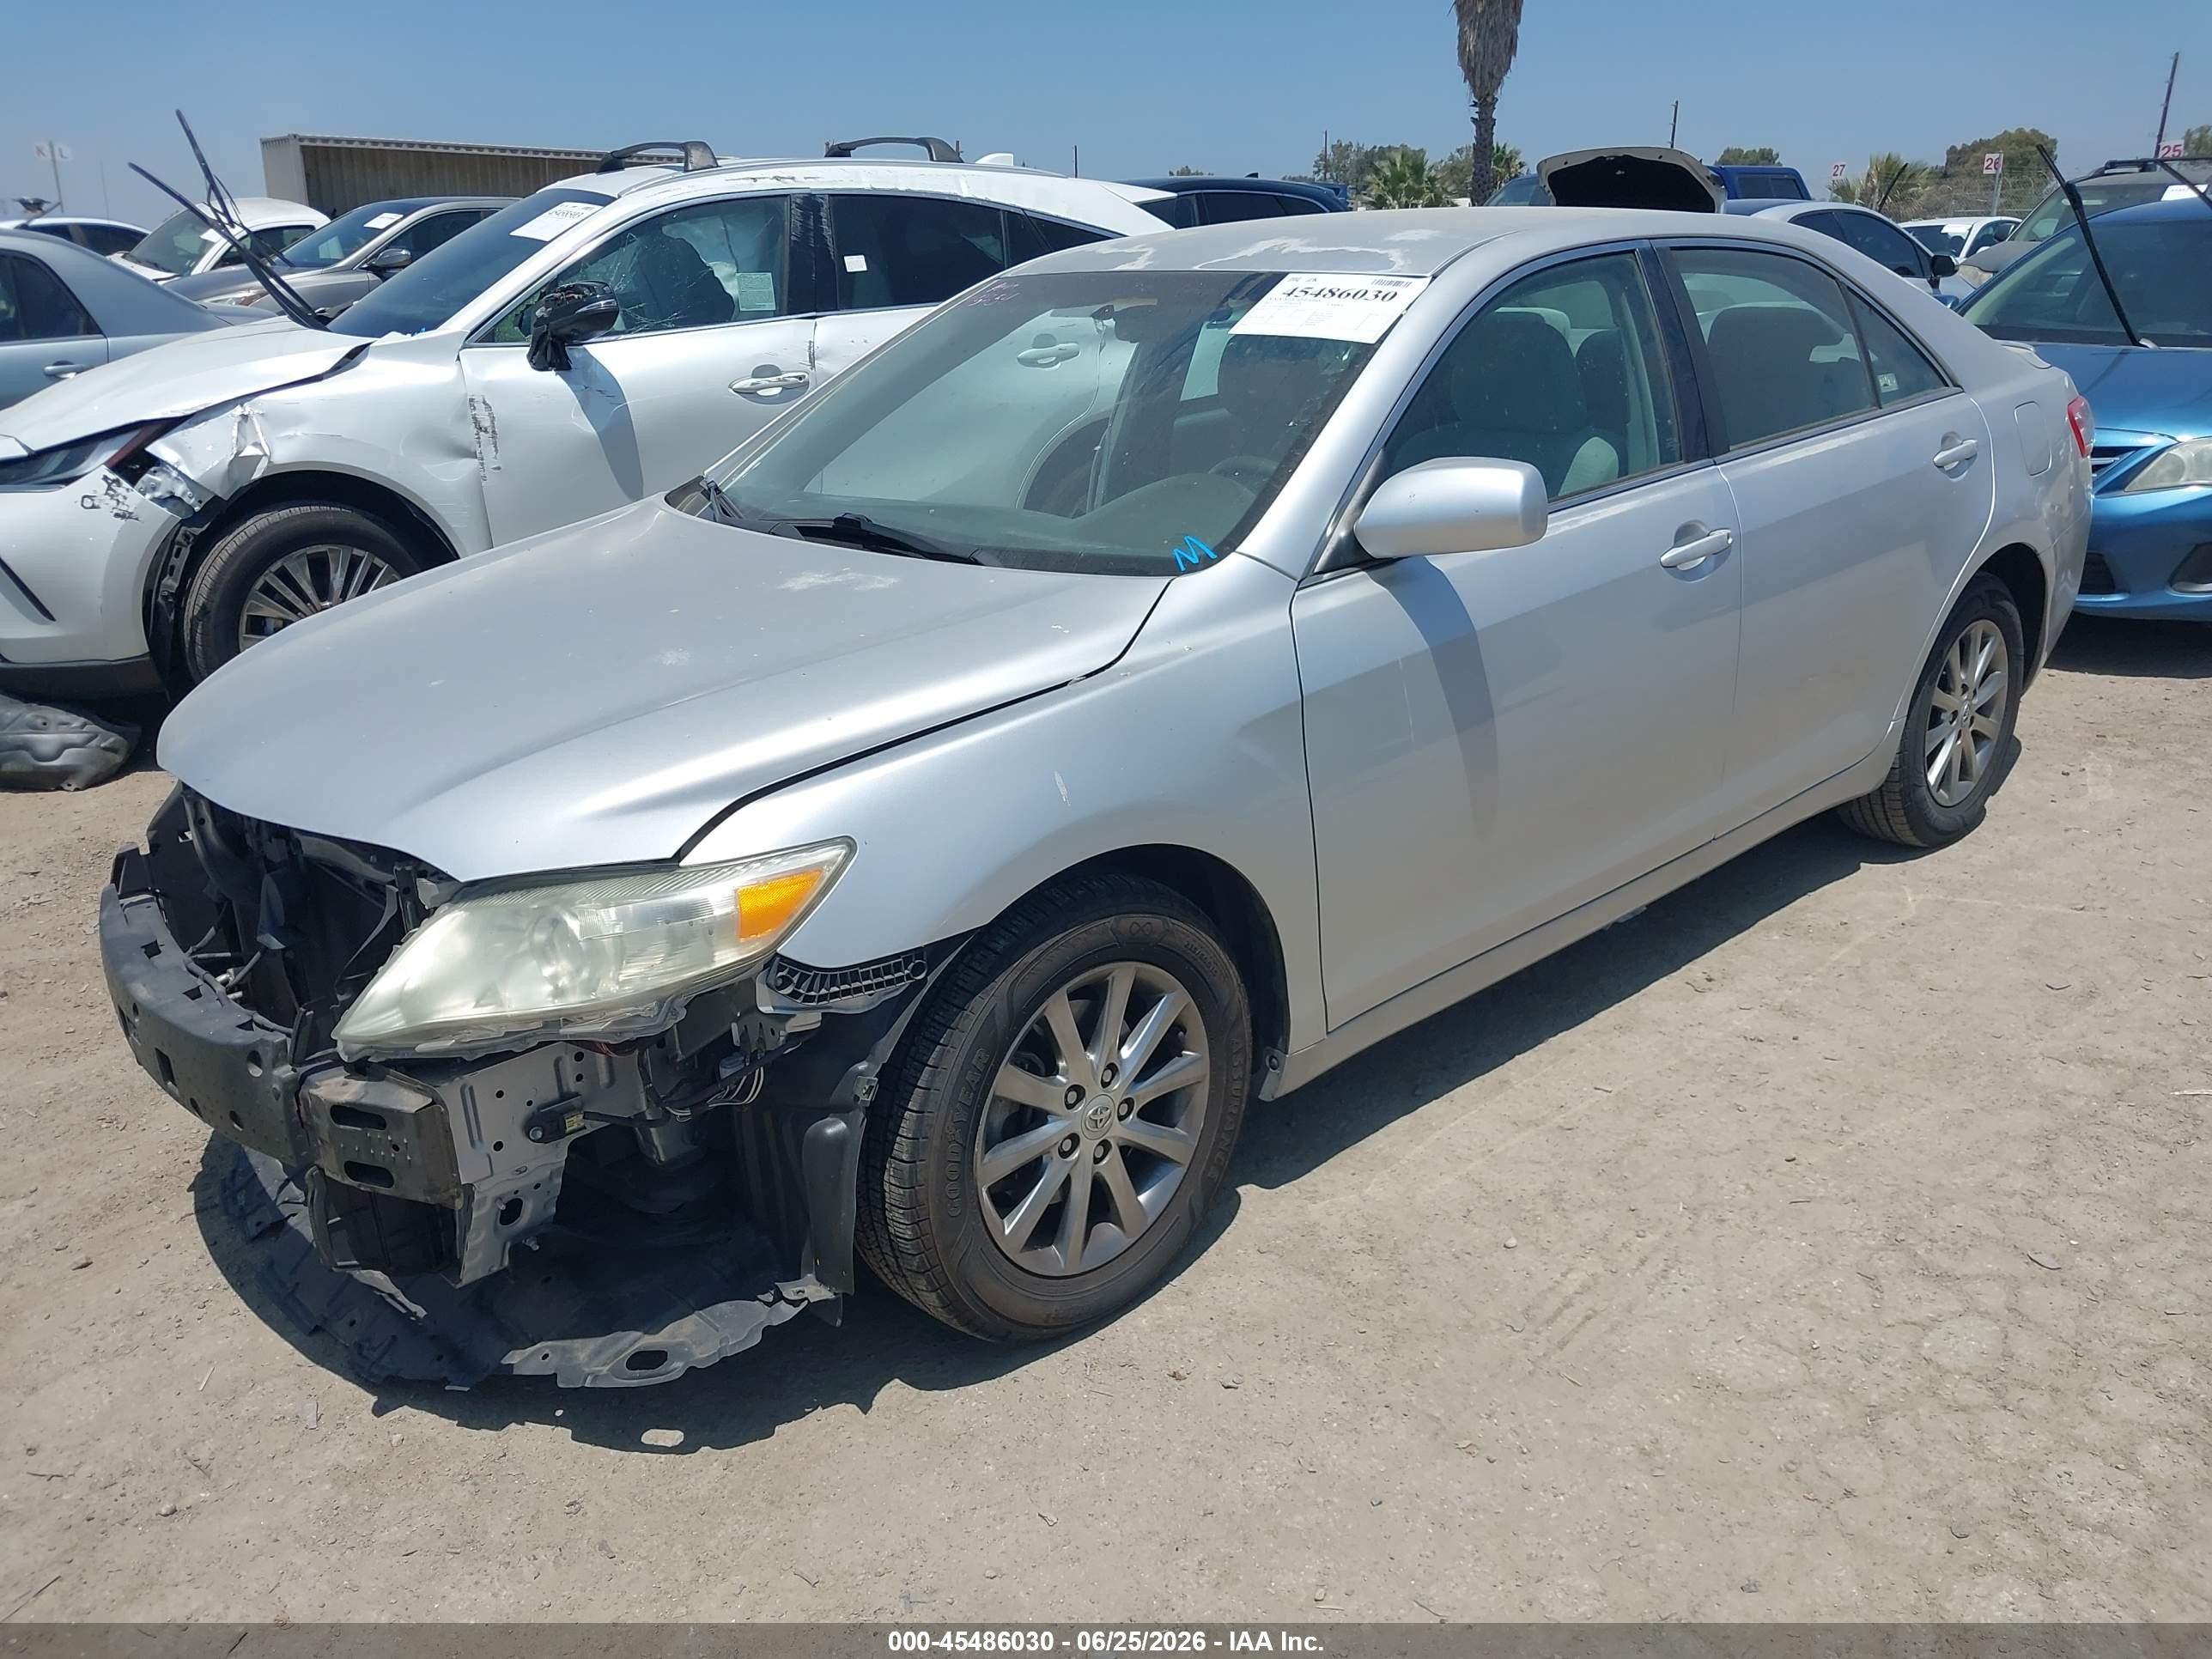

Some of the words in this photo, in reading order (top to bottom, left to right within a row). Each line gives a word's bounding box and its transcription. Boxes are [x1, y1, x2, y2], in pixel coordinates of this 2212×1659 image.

[2161, 144, 2182, 158] 25
[1832, 164, 1845, 176] 27
[1282, 287, 1397, 301] 45486030
